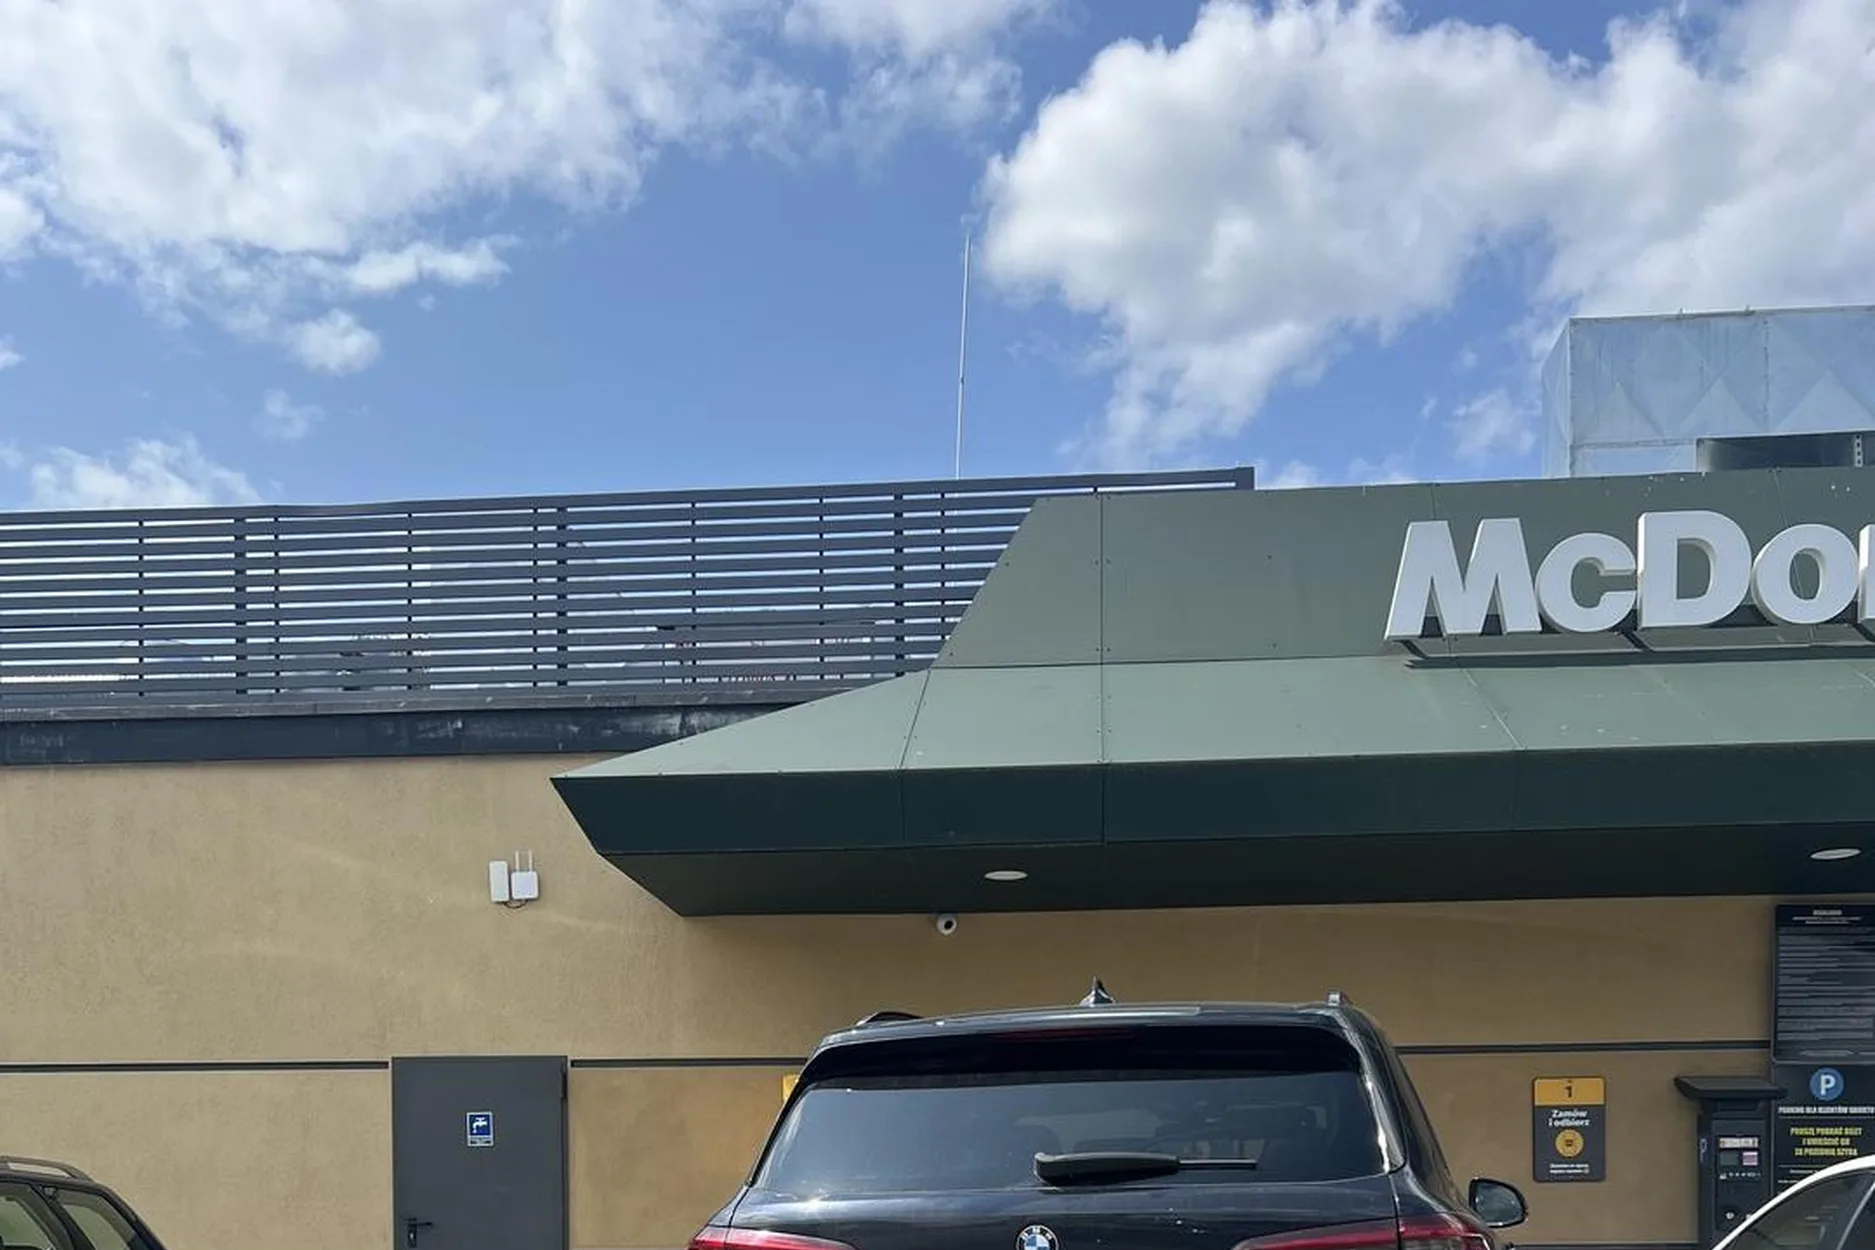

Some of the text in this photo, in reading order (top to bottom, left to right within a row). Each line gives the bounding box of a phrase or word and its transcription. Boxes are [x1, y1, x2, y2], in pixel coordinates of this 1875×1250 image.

[1384, 510, 1875, 640] McDo
[1564, 1085, 1573, 1098] 1
[1820, 1074, 1836, 1096] P
